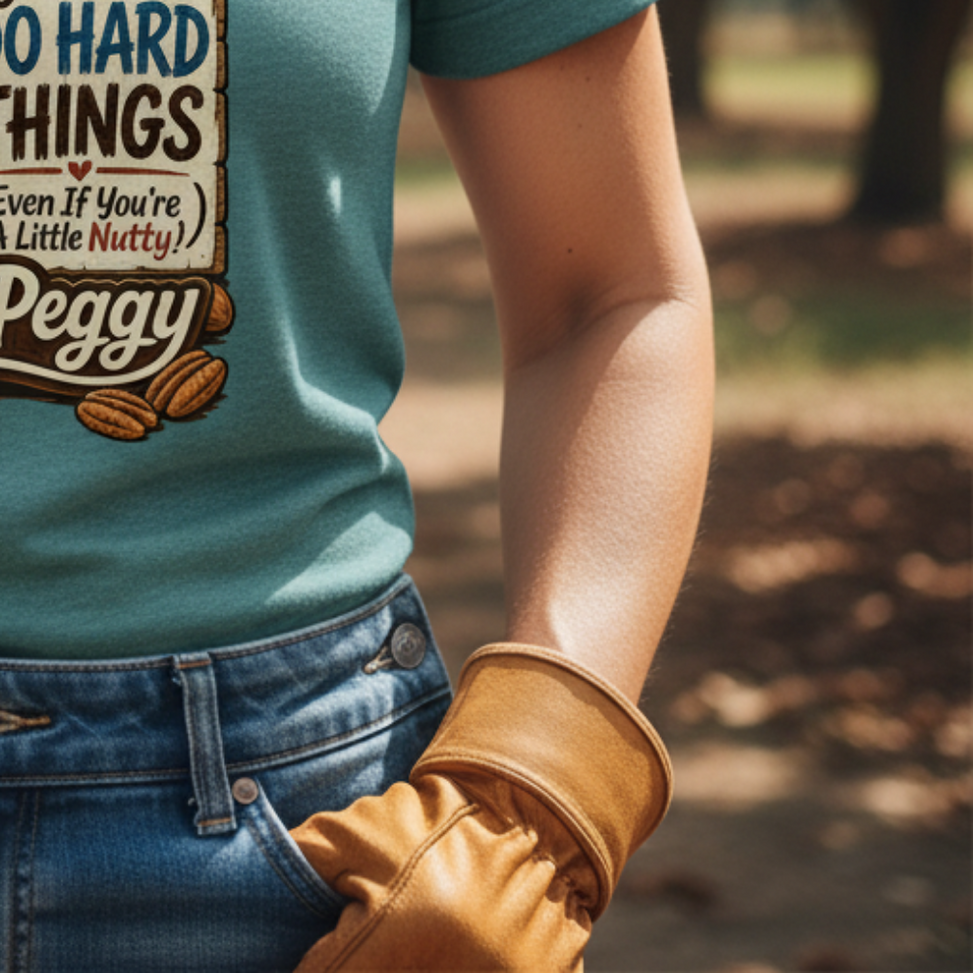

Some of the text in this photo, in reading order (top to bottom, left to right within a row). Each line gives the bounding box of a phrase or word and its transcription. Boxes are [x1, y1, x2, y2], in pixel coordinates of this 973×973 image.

[56, 0, 210, 78] HARD
[60, 186, 91, 218] If
[96, 186, 181, 219] You're
[14, 221, 82, 251] Little
